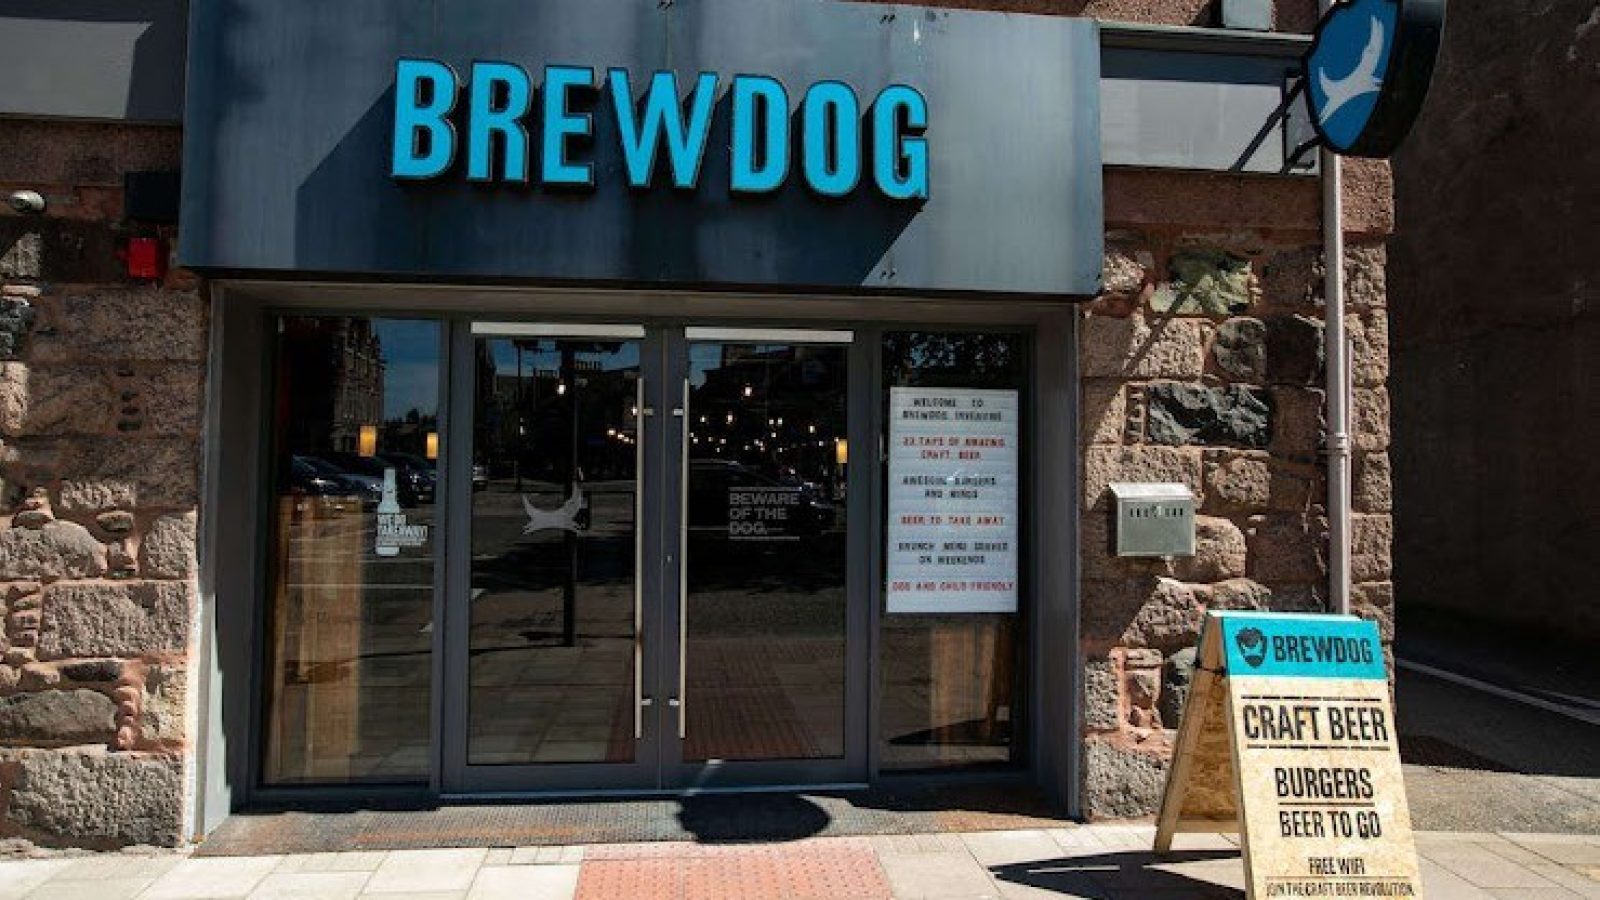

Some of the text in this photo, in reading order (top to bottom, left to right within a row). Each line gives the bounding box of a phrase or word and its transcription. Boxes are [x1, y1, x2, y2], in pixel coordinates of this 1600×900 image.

[391, 58, 930, 201] BREWDOG
[913, 397, 984, 408] WELCOME TO
[903, 410, 948, 421] BREWDOG
[921, 450, 981, 460] CRAFT BEER
[729, 492, 801, 505] BEWARE
[925, 489, 943, 498] AND
[729, 507, 788, 520] OF THE
[901, 515, 1004, 525] BEER TO TAKE AWAY
[899, 542, 935, 552] BRUNCH
[943, 542, 967, 552] MENU
[937, 555, 985, 566] WEEKENDS
[892, 581, 911, 591] DOG
[916, 581, 936, 591] AND
[970, 581, 1014, 591] FRIENDLY
[1272, 635, 1373, 663] BREWDOG
[1242, 704, 1388, 741] CRAFT BEER
[1274, 767, 1374, 799] BURGERS
[1279, 810, 1382, 839] BEER TO GO
[1307, 857, 1365, 875] FREE WIFI
[1266, 882, 1284, 897] JOIN
[1285, 882, 1304, 897] THE
[1305, 882, 1334, 897] CRAFT
[1335, 883, 1358, 897] BEER
